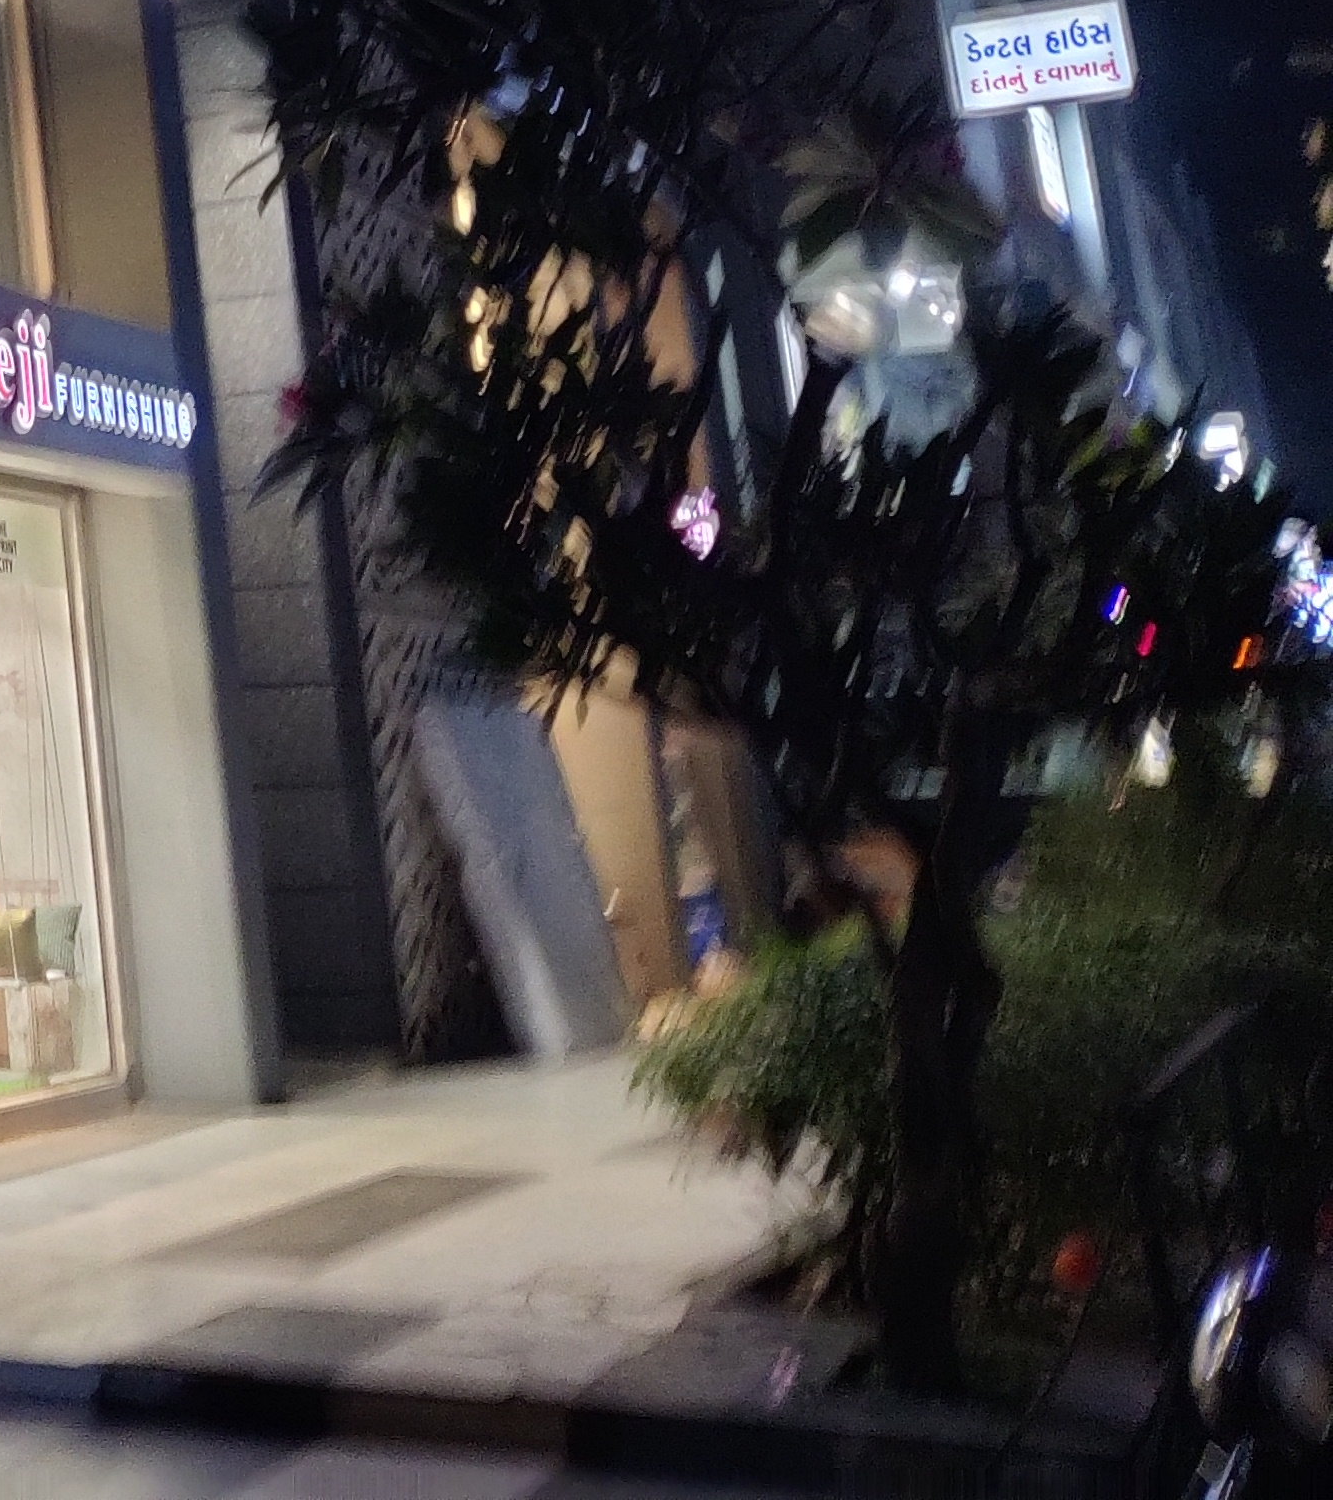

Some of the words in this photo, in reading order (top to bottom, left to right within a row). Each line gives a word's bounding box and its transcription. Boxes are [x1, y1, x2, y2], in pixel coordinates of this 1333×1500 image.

[963, 32, 1032, 63] ડેન્ટલ
[1045, 18, 1112, 55] હાઉસ
[970, 64, 1029, 95] દાંતનું
[1034, 51, 1122, 85] દવાખાનું
[54, 372, 195, 445] FURNISHING
